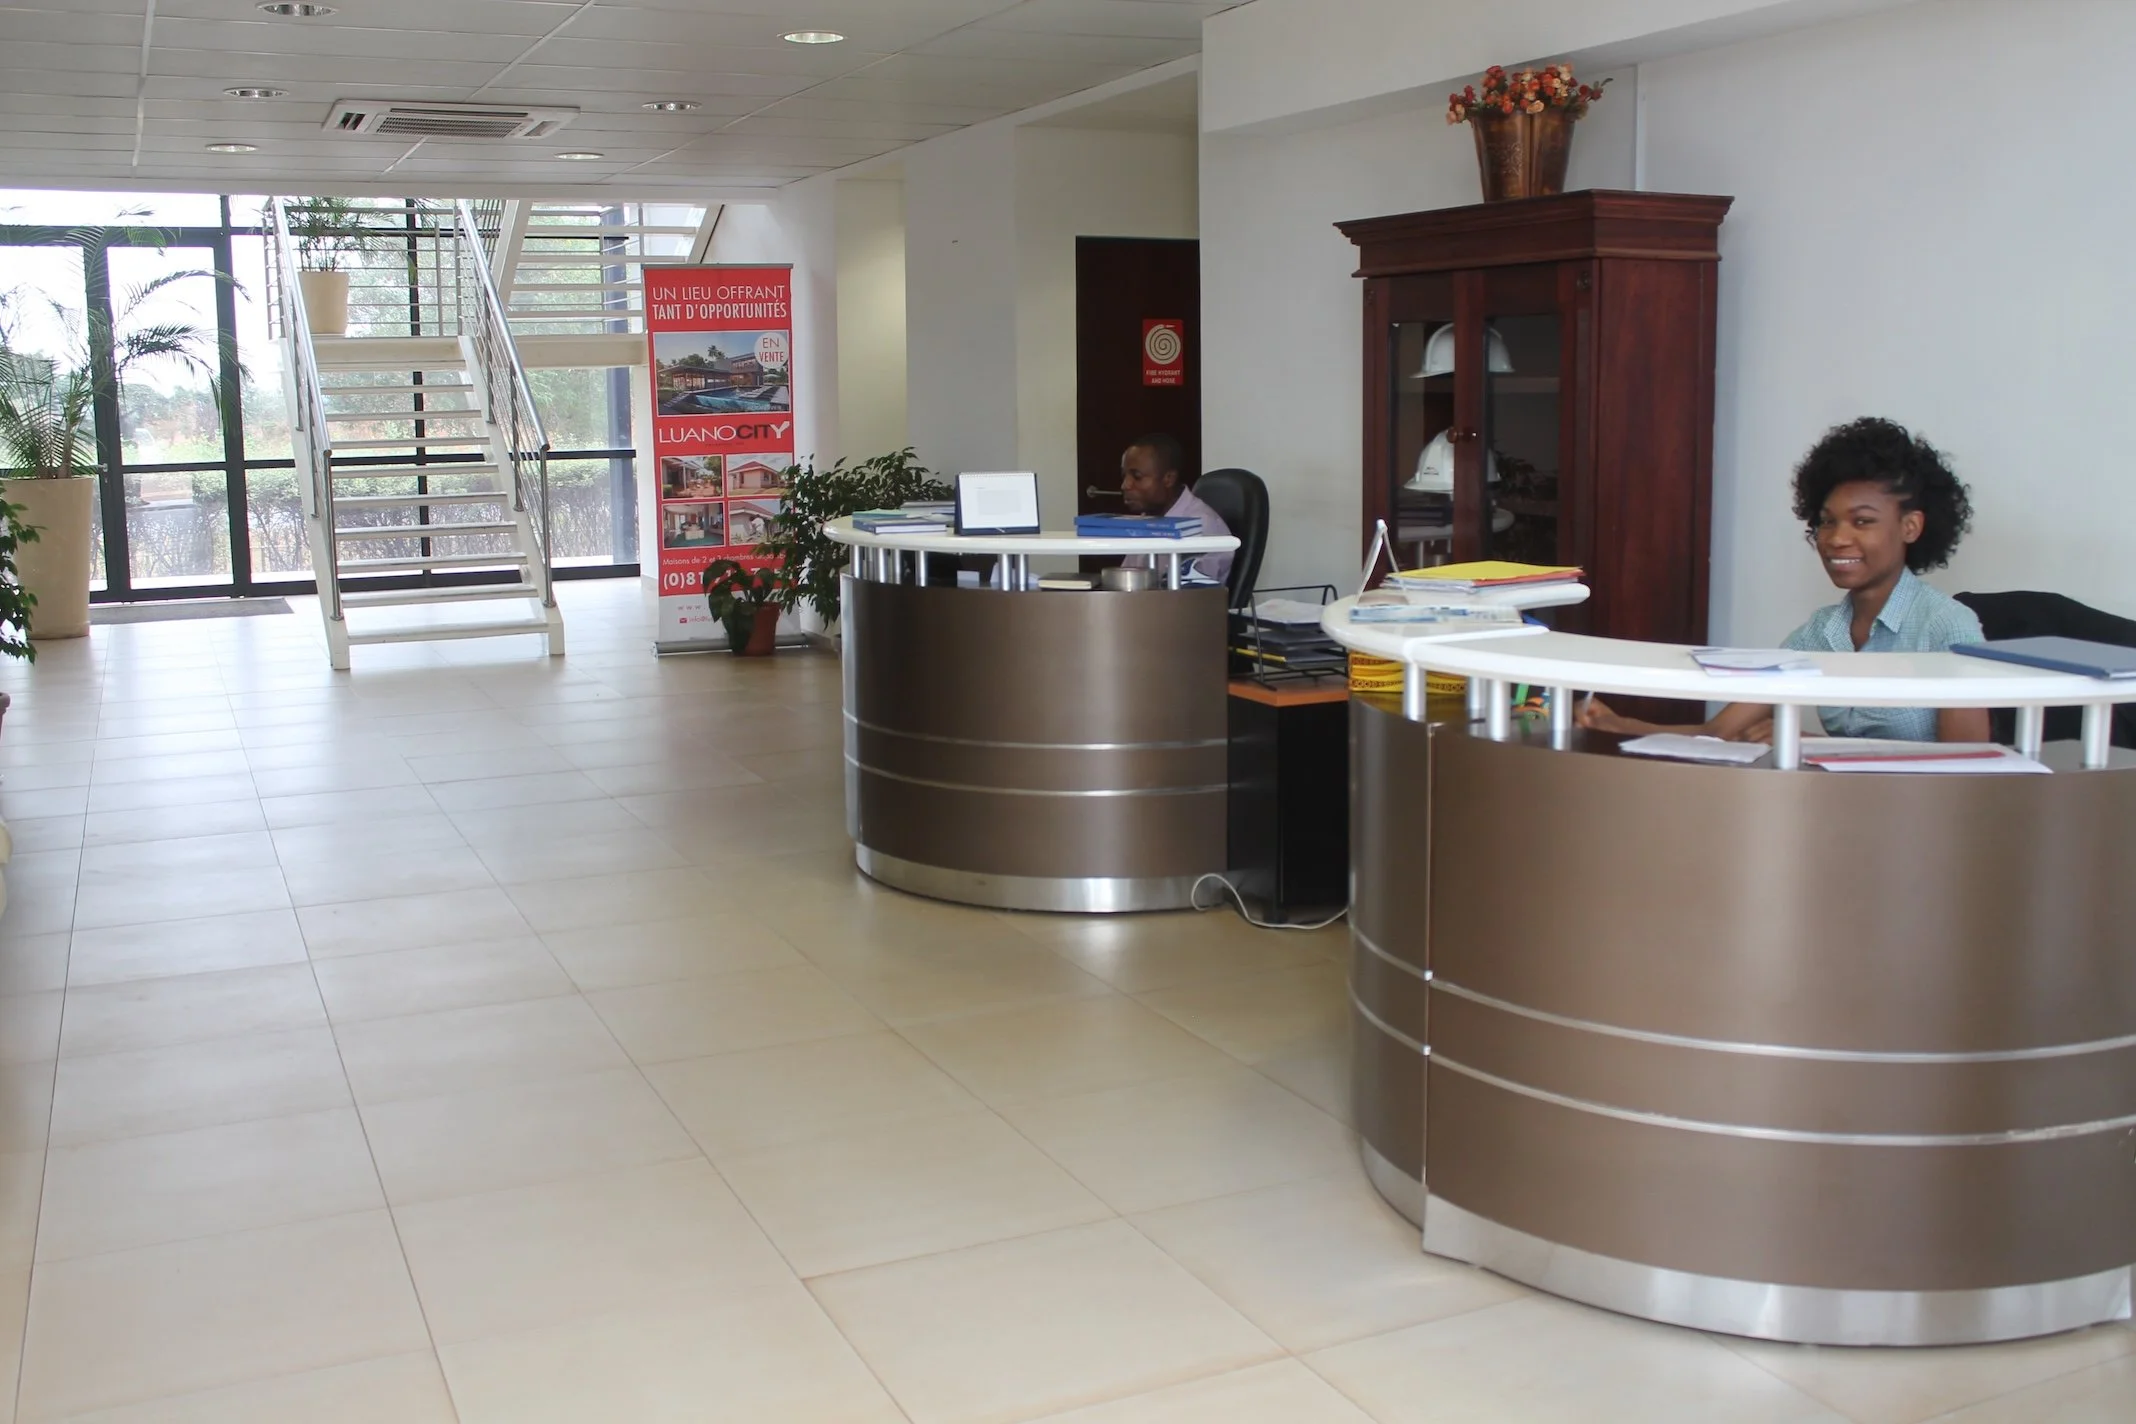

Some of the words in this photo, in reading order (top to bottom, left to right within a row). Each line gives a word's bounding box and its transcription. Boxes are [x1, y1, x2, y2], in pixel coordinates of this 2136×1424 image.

[652, 287, 676, 301] UN
[682, 286, 711, 300] LIEU
[716, 285, 785, 300] OFFRANT
[652, 303, 682, 320] TANT
[686, 299, 787, 320] D'OPPORTUNITÉS
[762, 337, 780, 348] EN
[759, 351, 784, 363] VENTE
[662, 557, 690, 566] Maisons
[691, 556, 701, 564] de
[702, 556, 707, 564] 2
